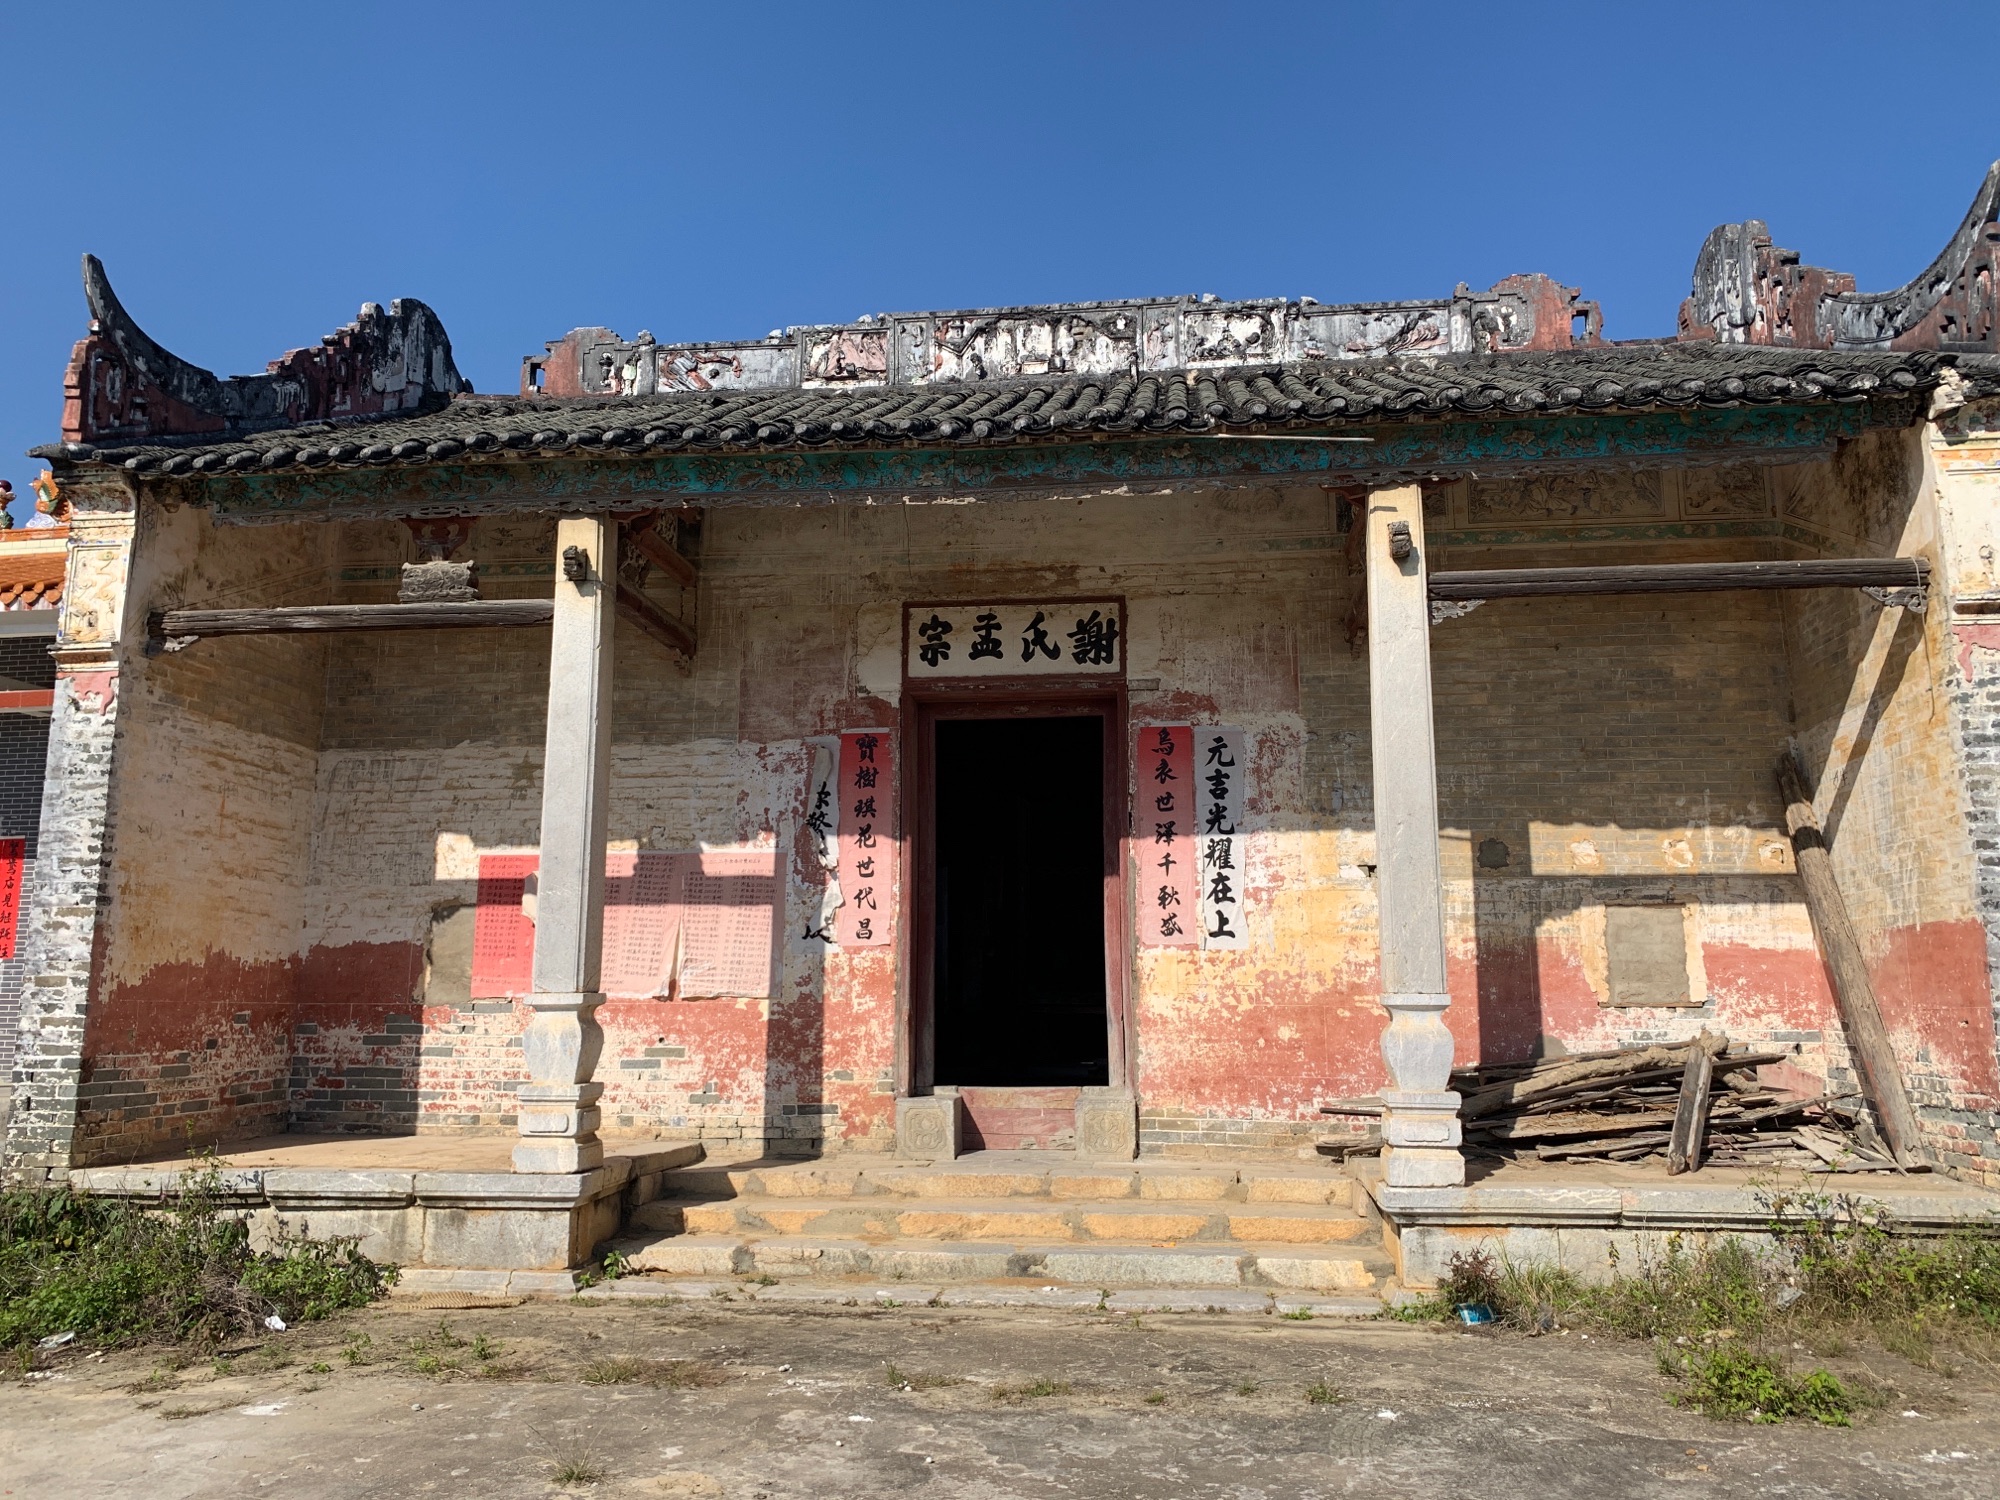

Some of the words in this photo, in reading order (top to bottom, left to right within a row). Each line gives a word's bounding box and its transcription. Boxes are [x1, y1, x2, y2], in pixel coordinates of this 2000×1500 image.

[918, 610, 1119, 668] 謝氏孟宗
[854, 733, 879, 941] 寶樹琪花世代昌
[1204, 736, 1236, 939] 元吉光耀在上
